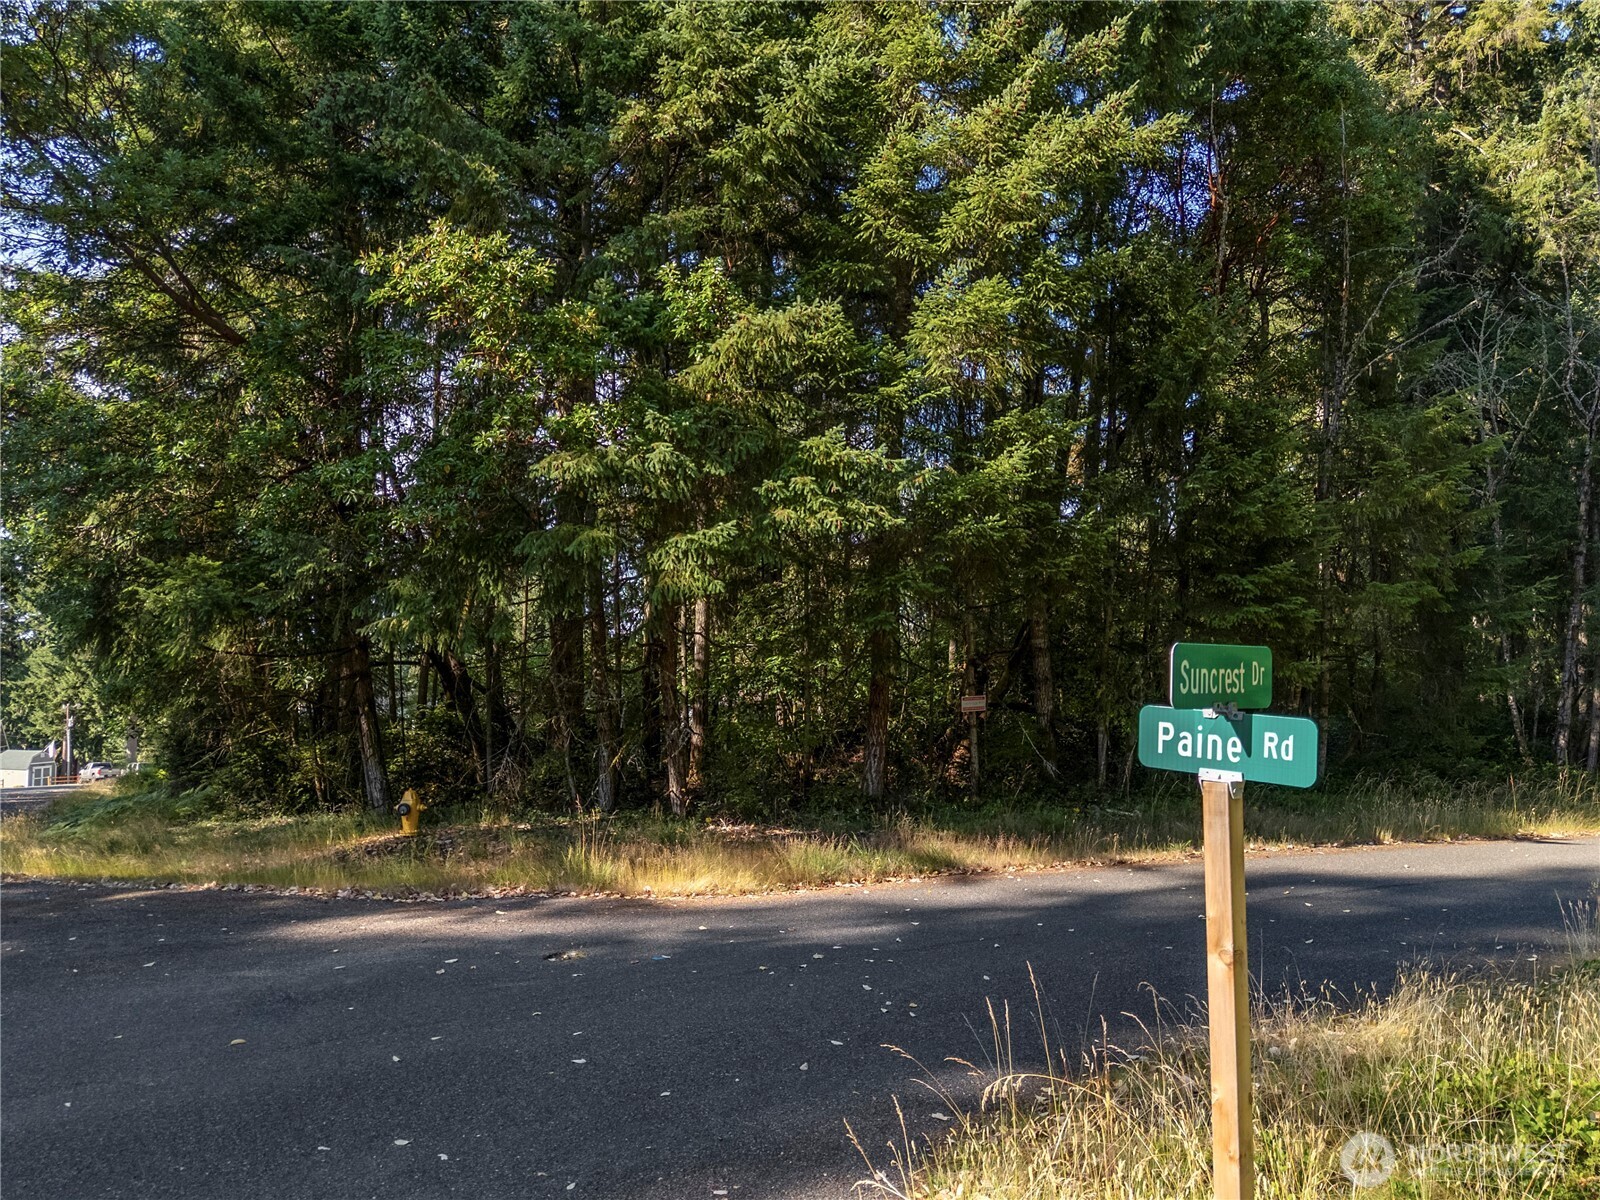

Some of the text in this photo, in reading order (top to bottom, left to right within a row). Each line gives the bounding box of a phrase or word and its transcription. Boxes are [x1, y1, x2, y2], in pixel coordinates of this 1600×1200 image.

[1180, 660, 1265, 694] Suncrest Dr
[1157, 721, 1294, 763] Paine Rd
